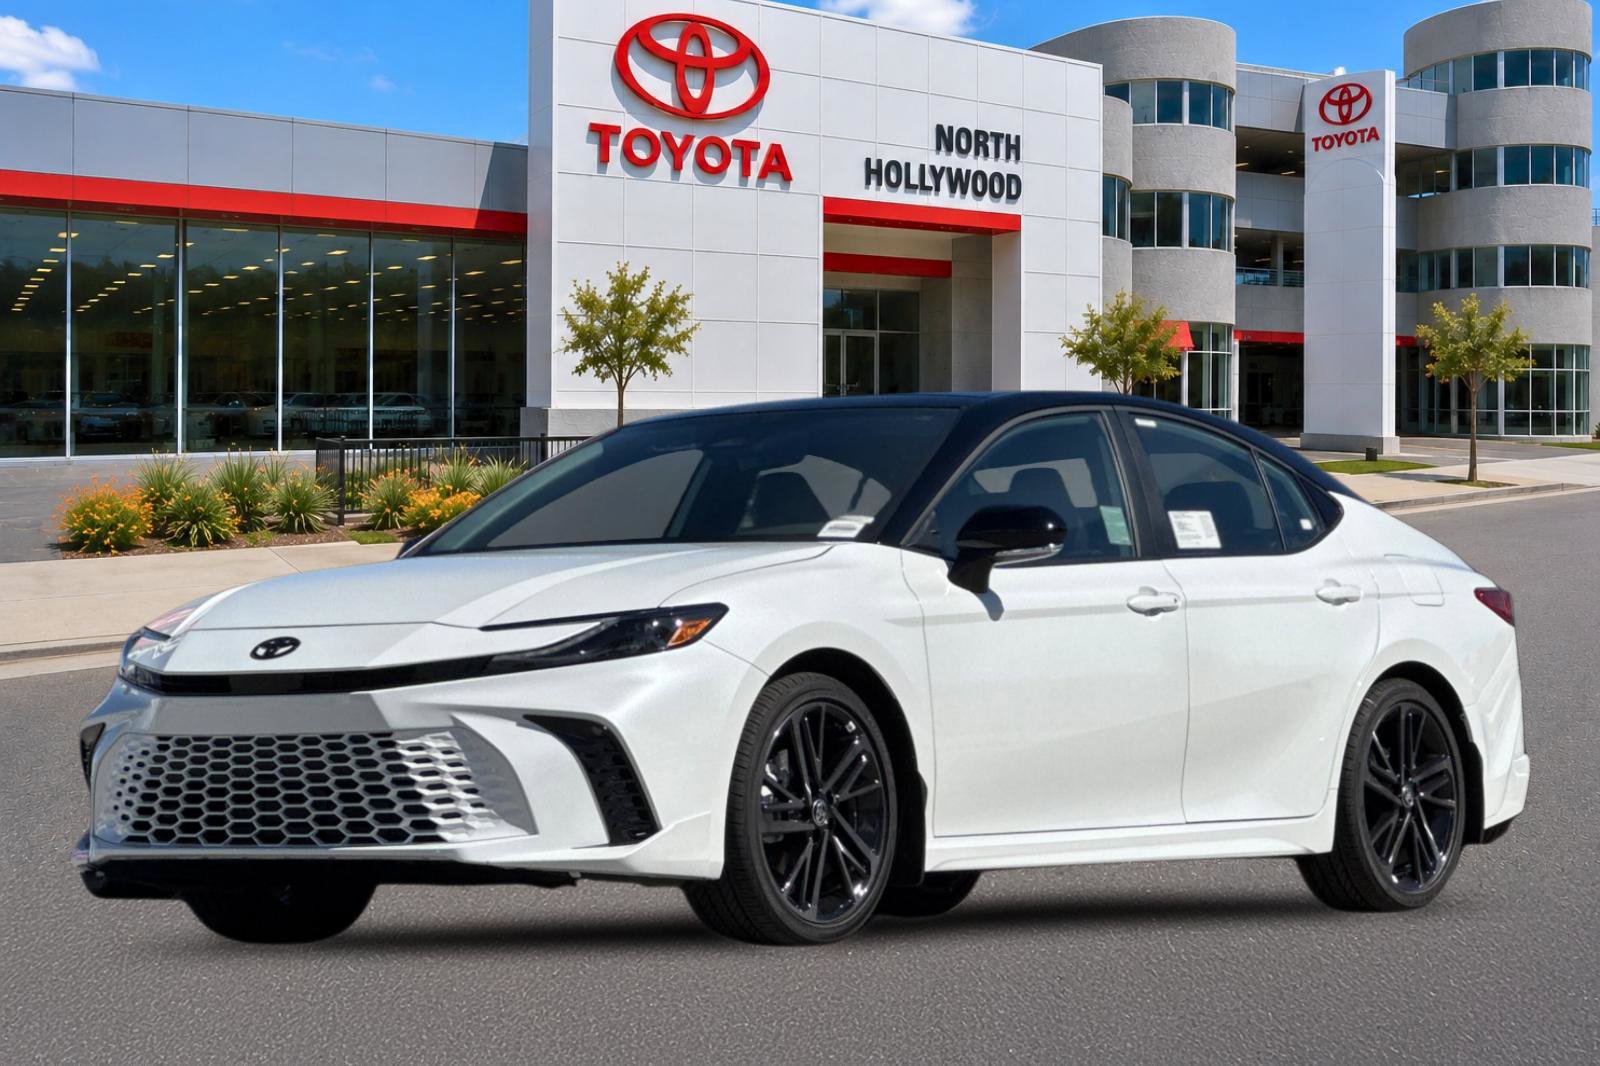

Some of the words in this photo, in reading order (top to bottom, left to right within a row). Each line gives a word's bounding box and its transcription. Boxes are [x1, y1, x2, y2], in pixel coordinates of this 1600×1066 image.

[589, 122, 793, 181] TOYOTA
[936, 124, 1021, 161] NORTH
[1313, 126, 1380, 152] TOYOTA
[865, 157, 1022, 200] HOLLYWOOD
